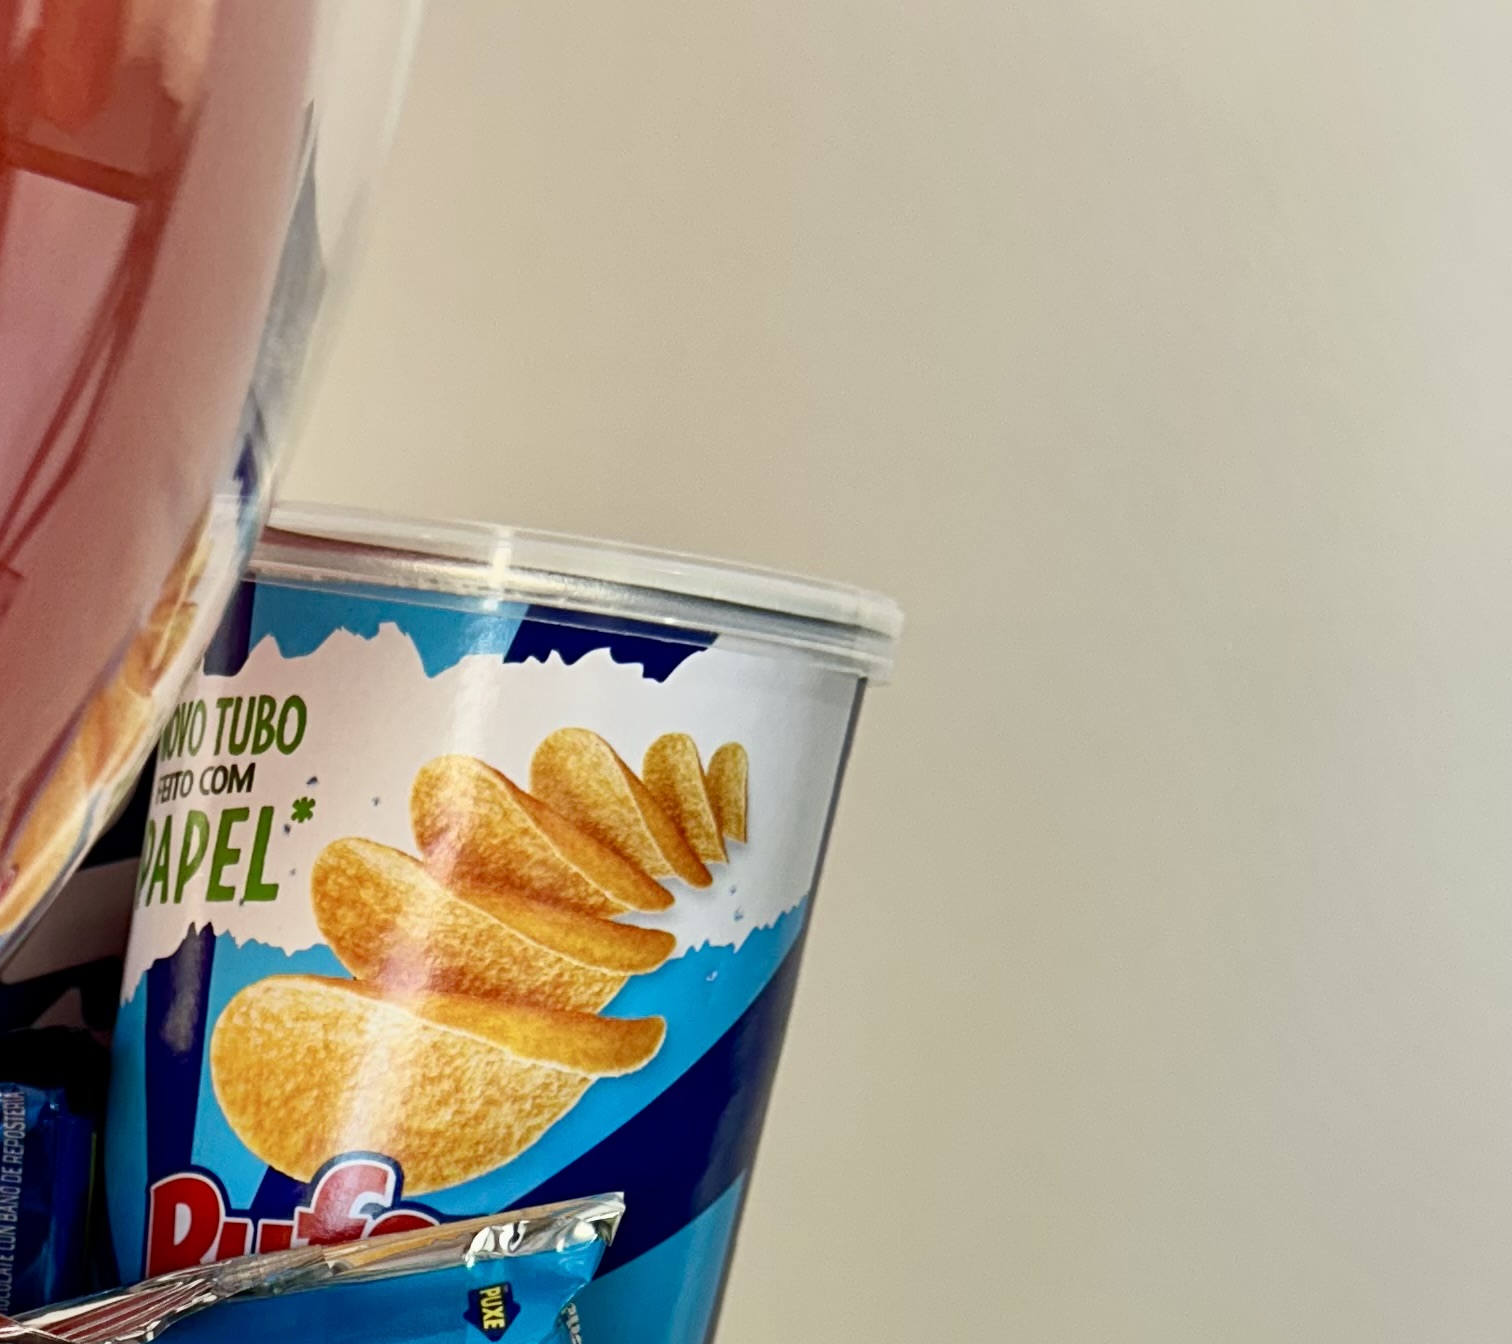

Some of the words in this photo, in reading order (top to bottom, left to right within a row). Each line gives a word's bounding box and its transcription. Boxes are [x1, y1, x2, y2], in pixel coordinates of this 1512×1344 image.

[214, 694, 307, 756] TUBO
[199, 762, 256, 796] COM
[0, 1166, 23, 1184] DE
[479, 1286, 506, 1330] PUXE
